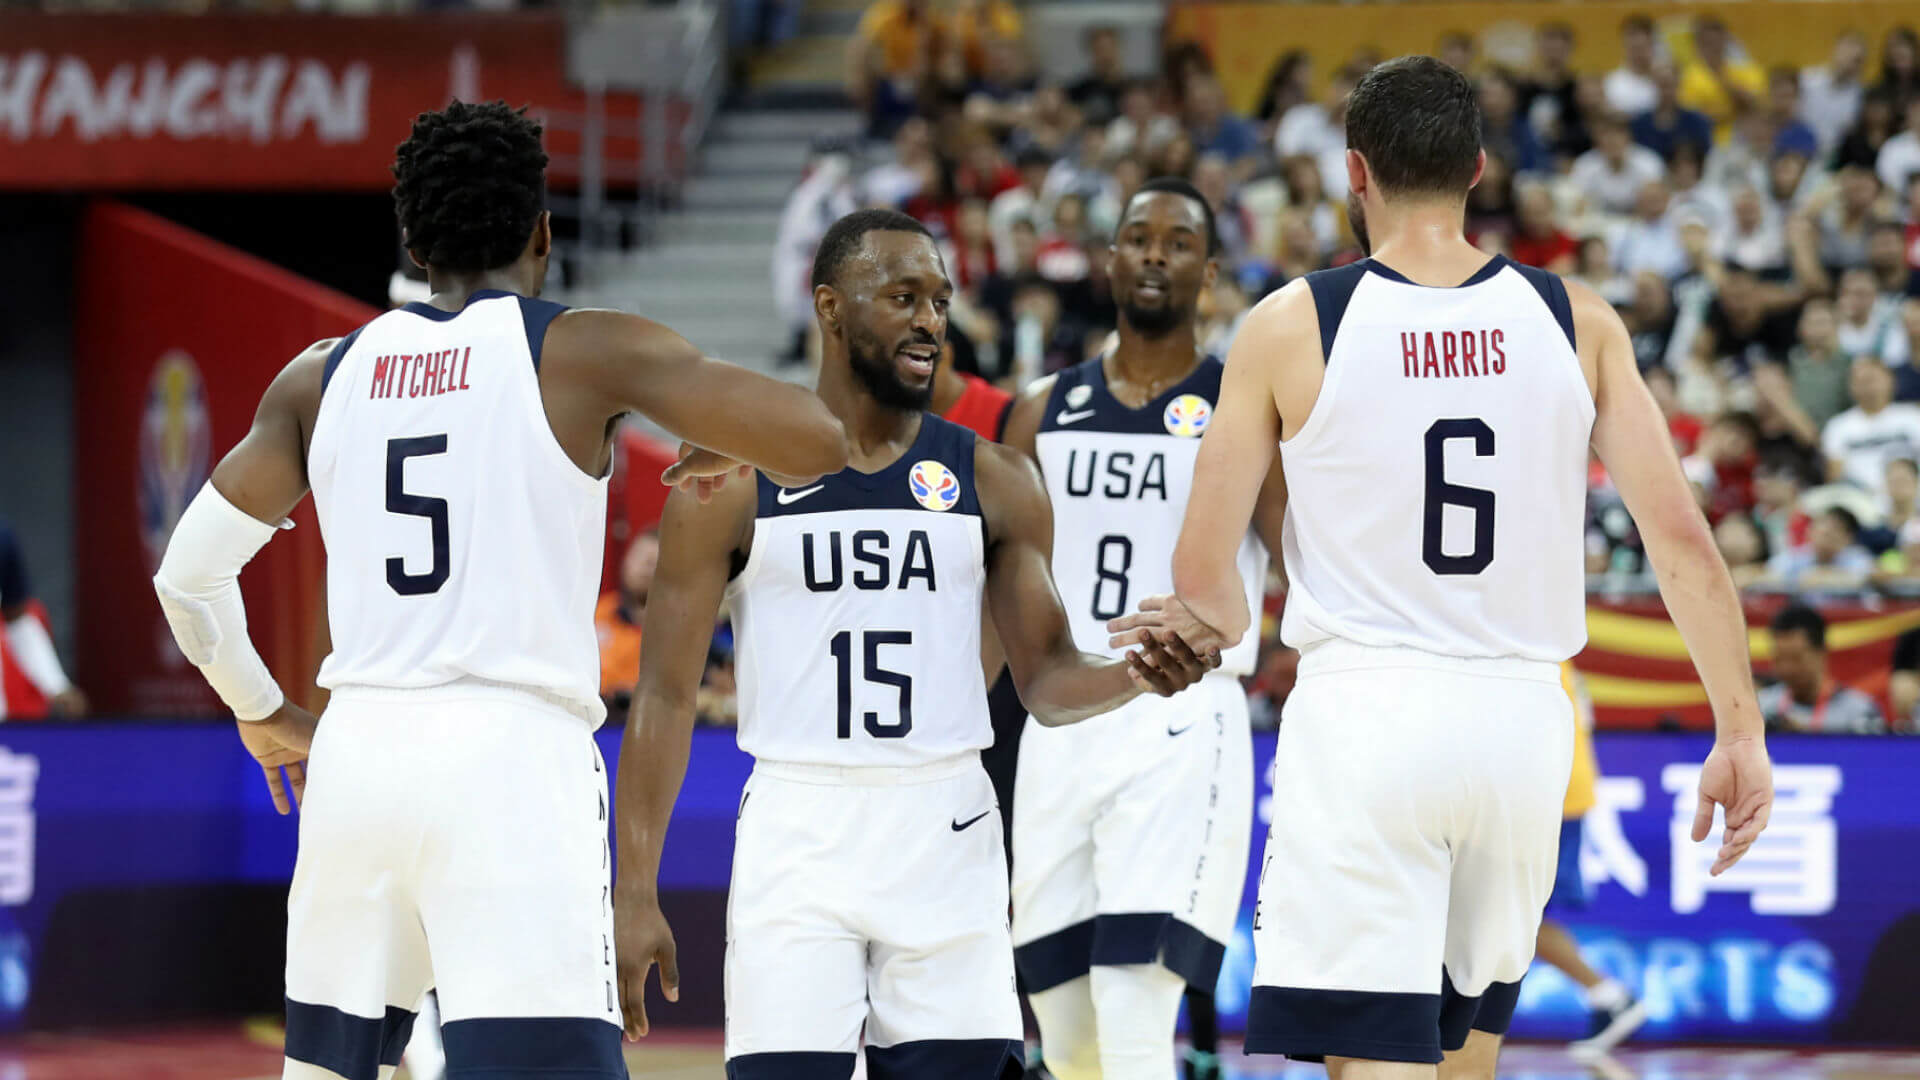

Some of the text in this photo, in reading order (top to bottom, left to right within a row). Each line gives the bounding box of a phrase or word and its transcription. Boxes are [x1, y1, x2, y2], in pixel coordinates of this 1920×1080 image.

[369, 346, 471, 400] MITCHELL
[1400, 328, 1506, 378] HARRIS
[1066, 449, 1167, 501] USA
[1422, 417, 1496, 575] 6
[385, 433, 450, 596] 5
[802, 529, 937, 593] USA
[1091, 534, 1133, 621] 8
[830, 630, 913, 739] 15
